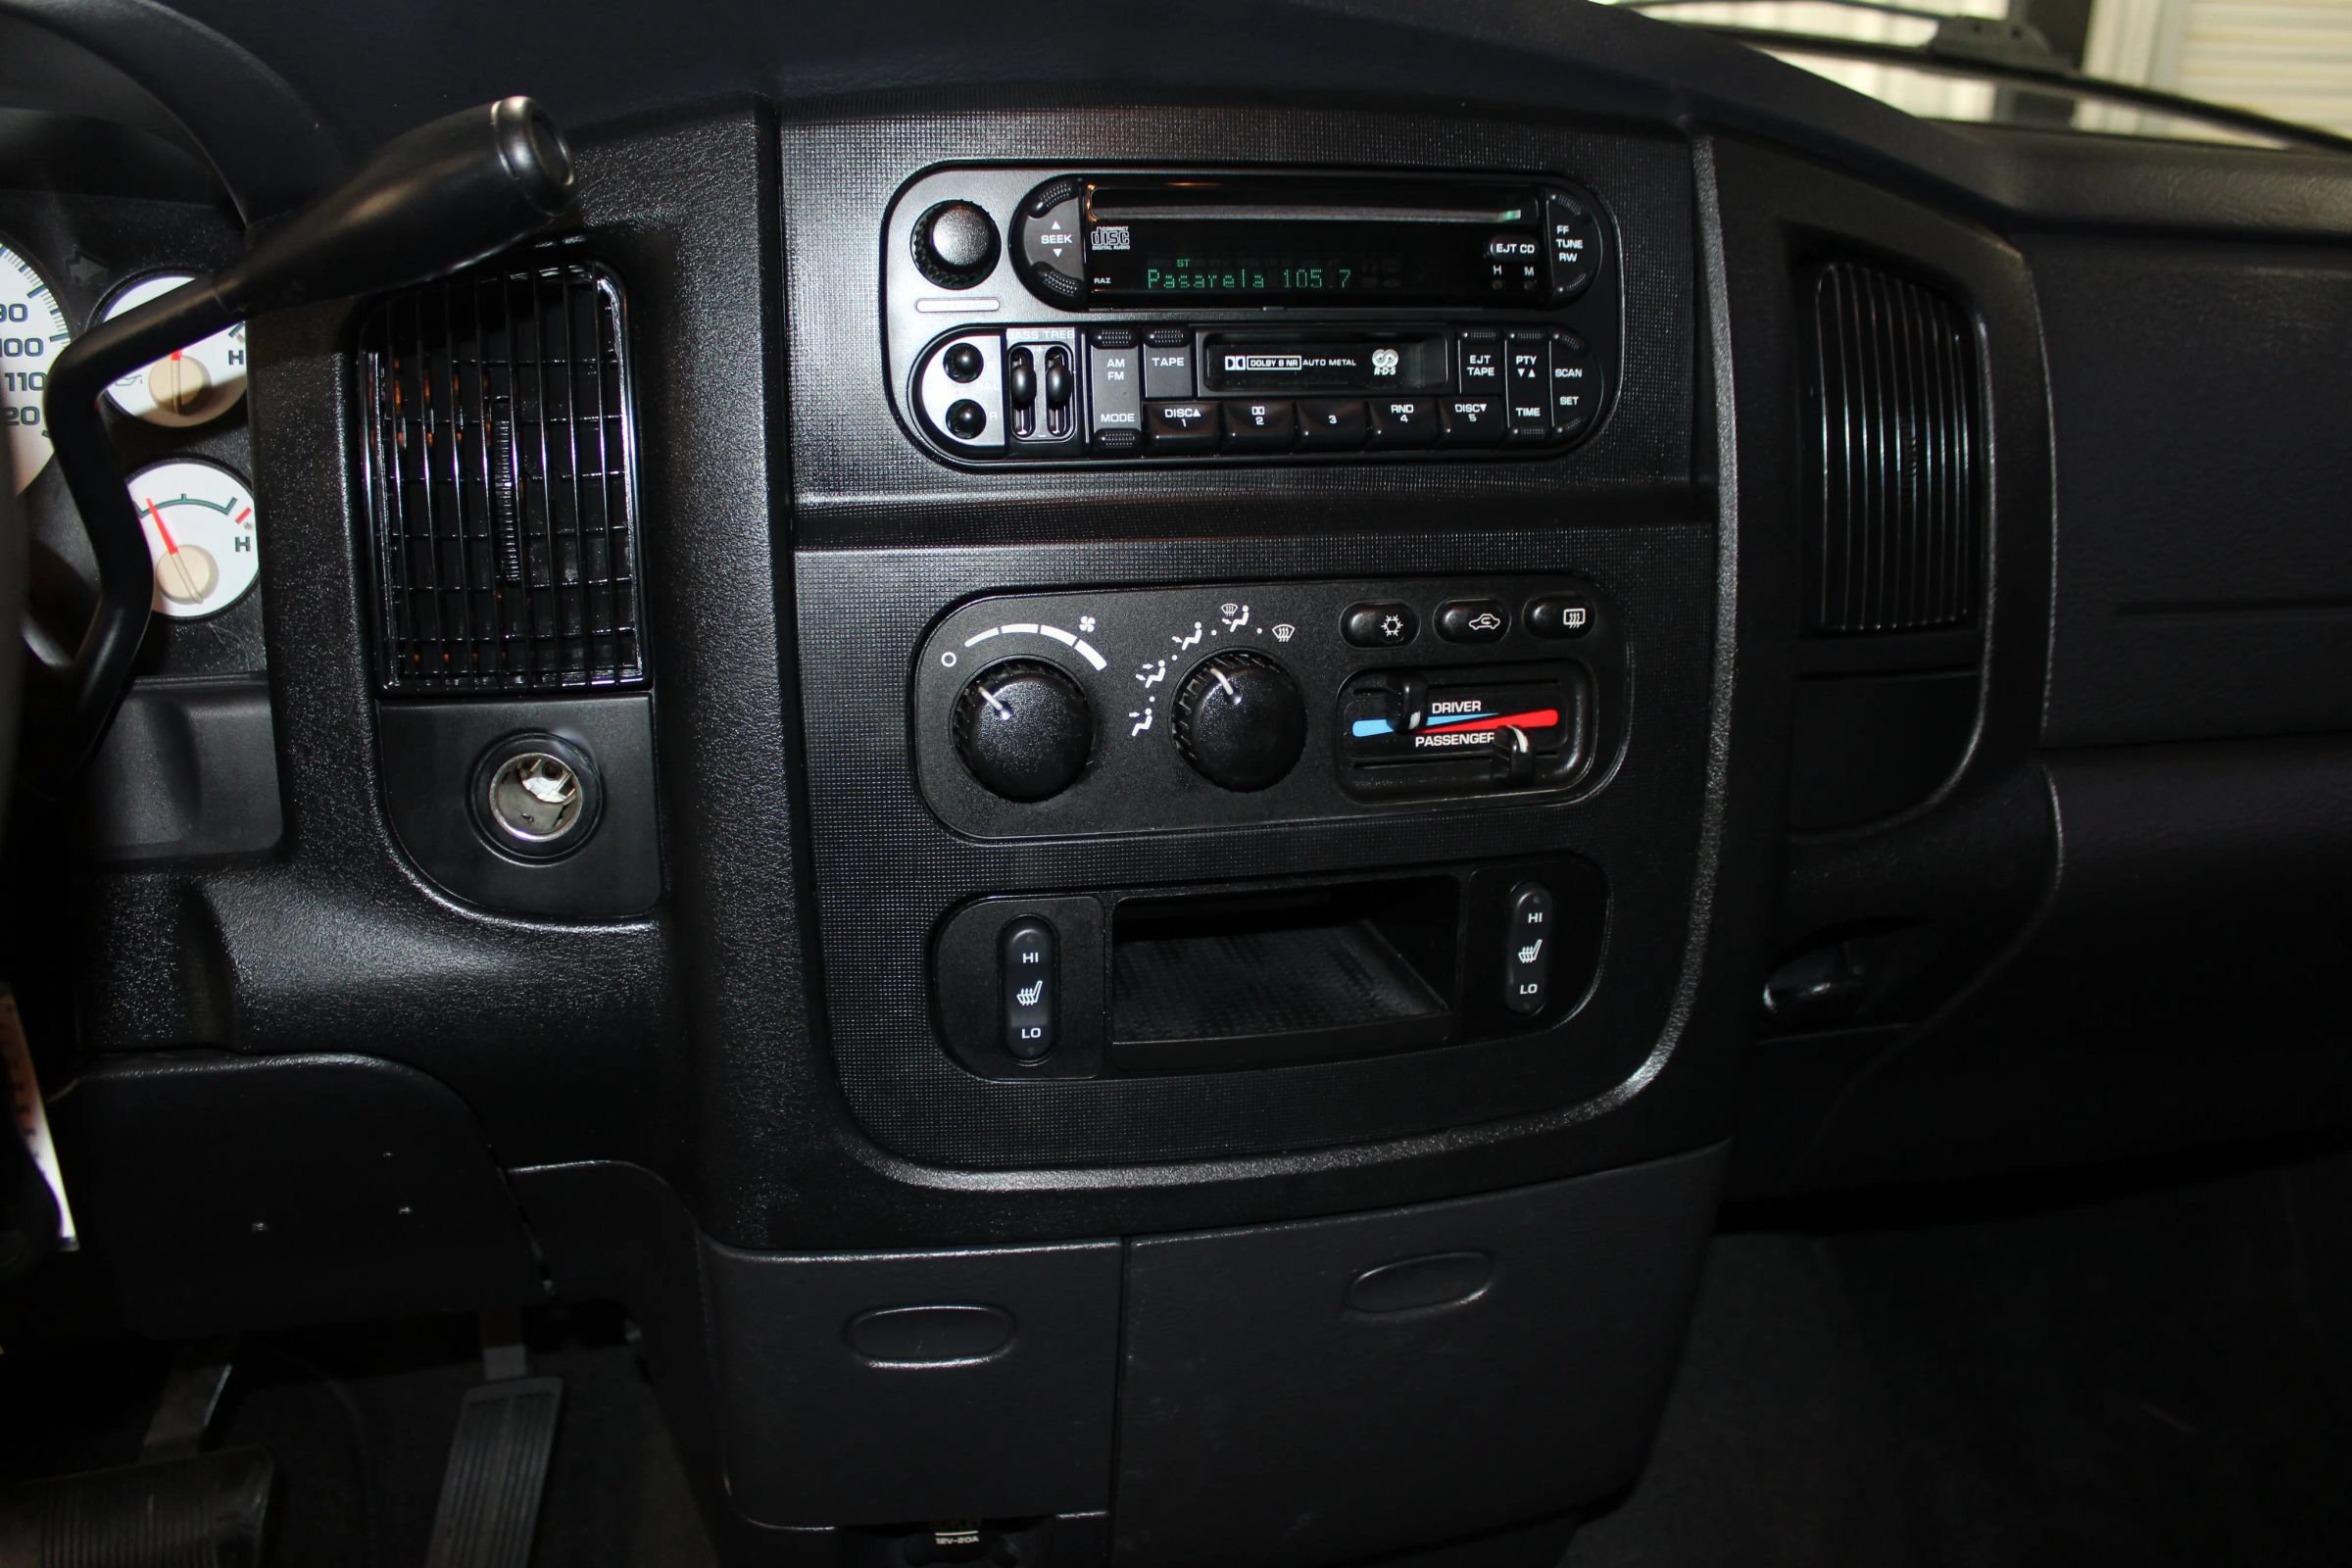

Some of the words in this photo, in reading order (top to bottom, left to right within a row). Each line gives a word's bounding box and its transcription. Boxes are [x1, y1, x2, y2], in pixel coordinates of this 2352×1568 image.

[1557, 225, 1569, 234] FF
[1042, 234, 1072, 244] SEEK
[1496, 244, 1516, 253] EJT
[1520, 244, 1535, 253] CD
[1556, 239, 1583, 249] TUNE
[1559, 253, 1577, 262] RW
[1494, 266, 1501, 274] H
[1525, 267, 1534, 275] M
[1148, 269, 1264, 288] Pasarela
[1007, 330, 1038, 340] BASS
[1042, 329, 1075, 339] TREB
[0, 338, 43, 358] 00
[228, 350, 244, 365] H
[1470, 355, 1491, 364] EJT
[1516, 356, 1537, 365] PTY
[1107, 359, 1124, 368] AM
[1152, 358, 1184, 367] TAPE
[1108, 371, 1124, 380] FM
[1555, 368, 1582, 377] SCAN
[5, 372, 47, 391] 110
[1165, 409, 1194, 417] DISC
[1455, 404, 1481, 413] DISC
[1516, 408, 1540, 416] TIME
[1101, 414, 1134, 422] MODE
[1181, 418, 1187, 427] 1
[235, 537, 250, 552] H
[1433, 701, 1481, 713] DRIVER
[1529, 912, 1543, 923] HI
[1023, 953, 1038, 963] HI
[1520, 984, 1538, 994] LO
[1022, 1028, 1041, 1038] LO
